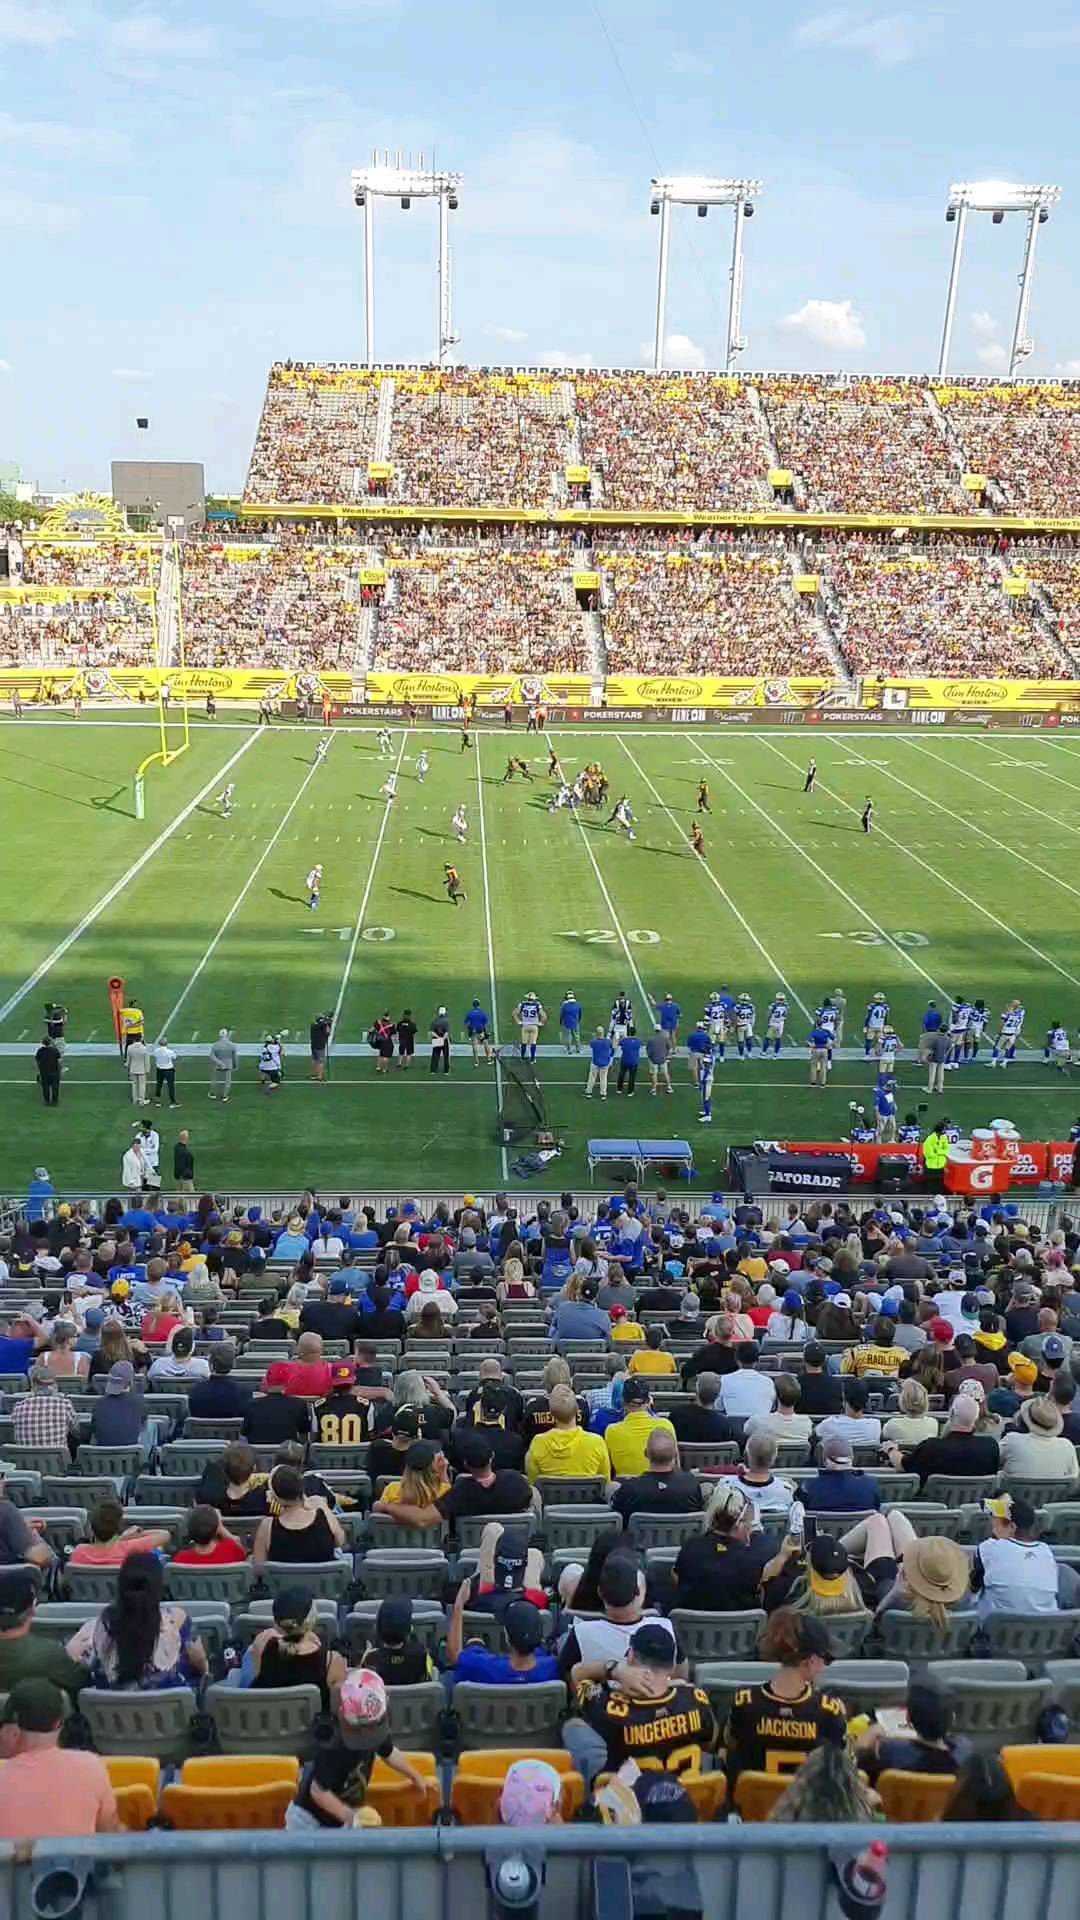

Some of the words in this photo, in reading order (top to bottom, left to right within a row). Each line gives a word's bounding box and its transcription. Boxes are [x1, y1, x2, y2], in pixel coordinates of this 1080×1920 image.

[341, 506, 404, 515] WeatherTech
[641, 681, 661, 697] Tim
[661, 680, 701, 697] Hortons
[343, 707, 403, 717] POKERSTARS
[583, 710, 643, 720] POKERSTARS
[823, 712, 883, 722] POKERSTARS
[329, 927, 396, 941] 10
[583, 929, 661, 944] 20
[847, 931, 930, 946] 30
[970, 1165, 993, 1190] G
[320, 1413, 361, 1442] 80
[623, 1713, 688, 1746] UNGERER
[688, 1709, 701, 1733] III
[755, 1716, 817, 1741] JACKSON
